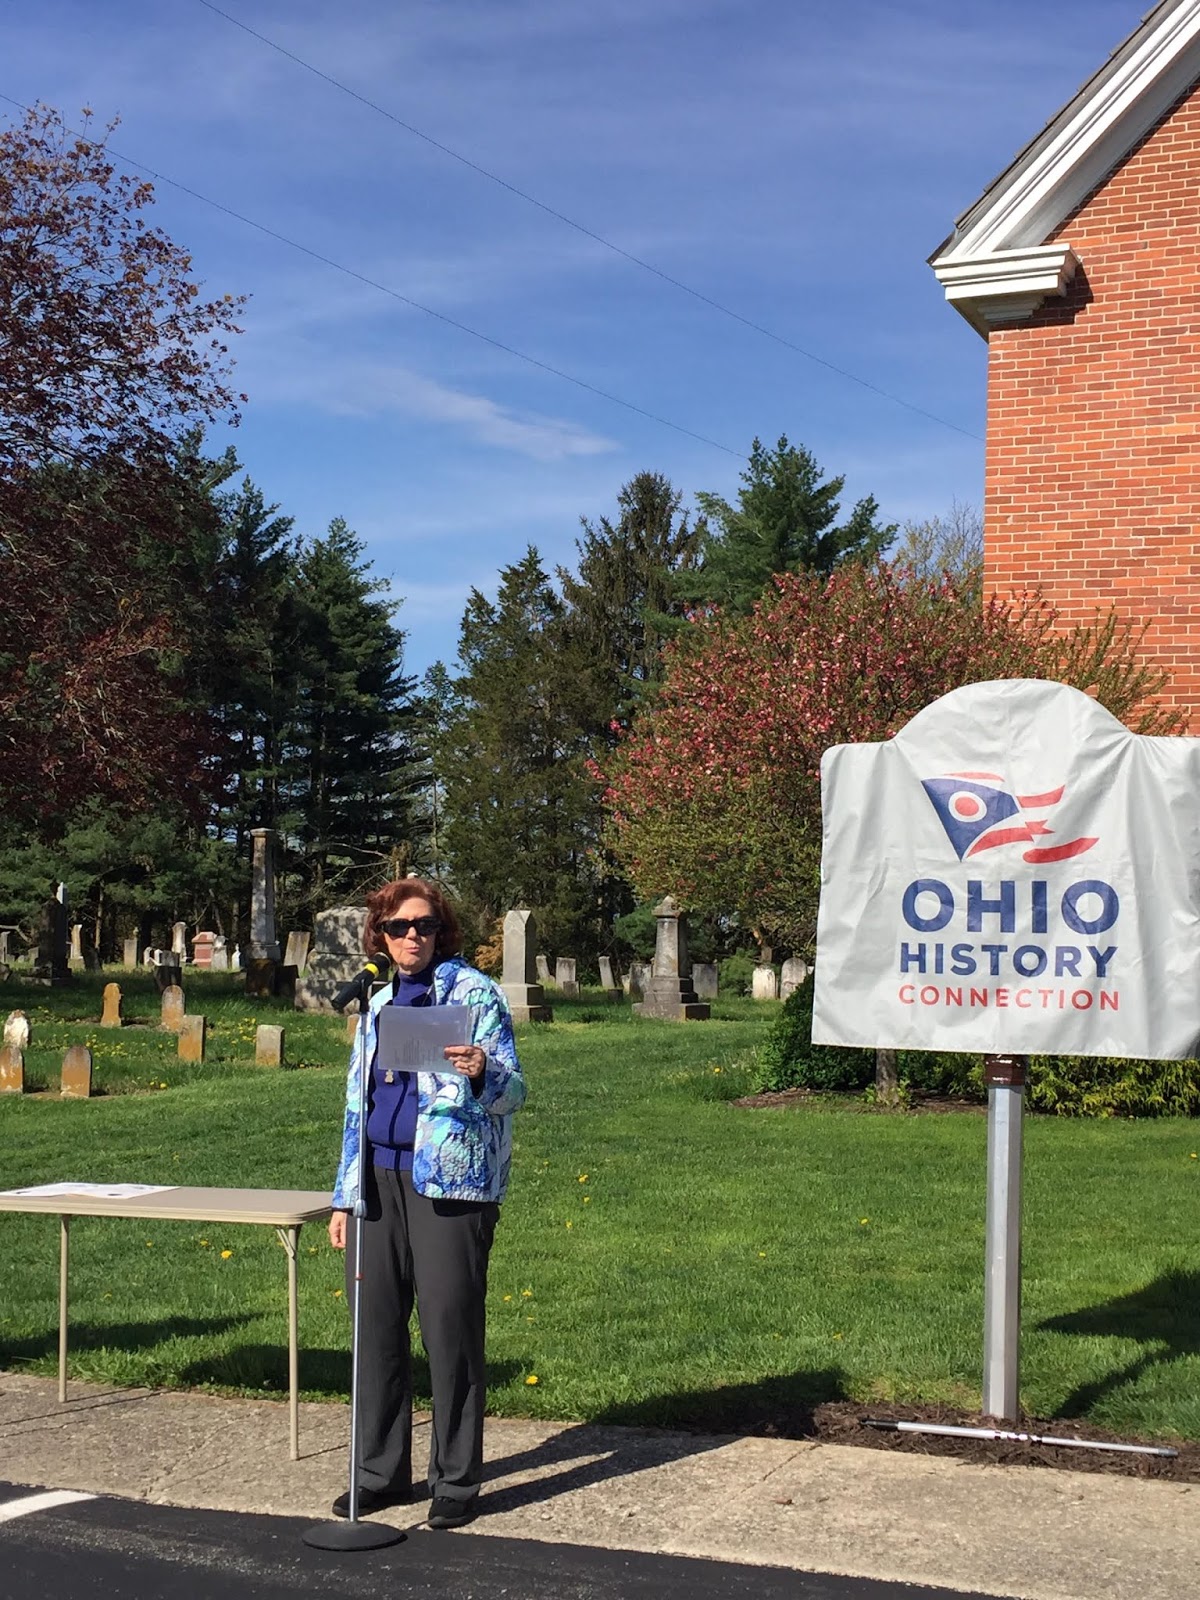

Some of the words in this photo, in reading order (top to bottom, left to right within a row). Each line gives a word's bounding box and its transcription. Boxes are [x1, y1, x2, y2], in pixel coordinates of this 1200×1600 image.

[902, 878, 1120, 934] OHIO
[900, 942, 1119, 978] HISTORY
[898, 984, 1119, 1011] CONNECTION
